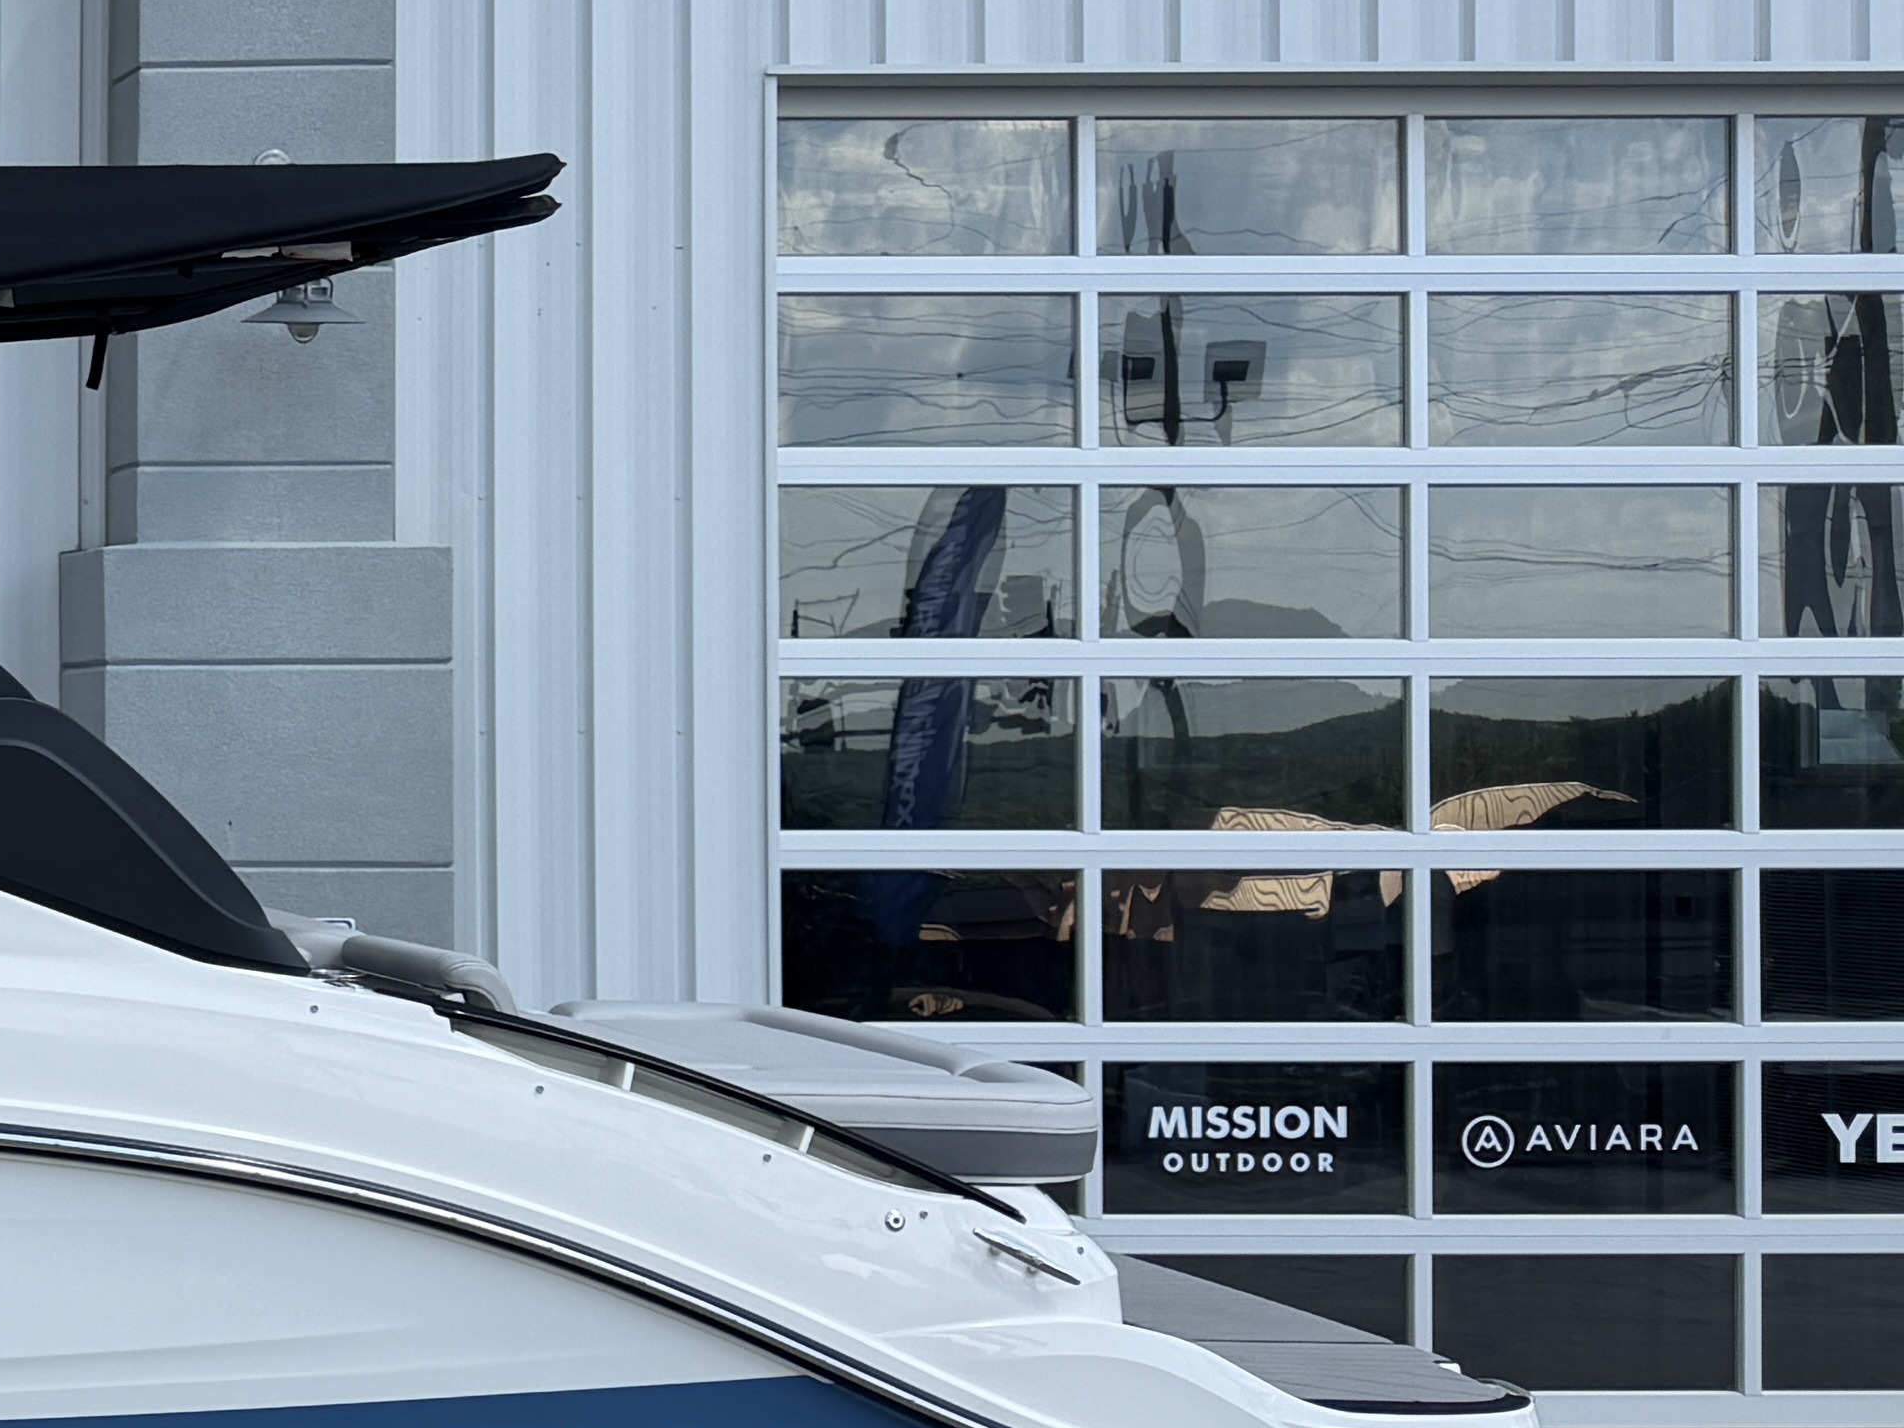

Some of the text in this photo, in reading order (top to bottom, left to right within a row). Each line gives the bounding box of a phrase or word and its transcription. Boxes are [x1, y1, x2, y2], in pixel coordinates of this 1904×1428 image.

[1149, 1106, 1347, 1138] MISSION
[1526, 1124, 1698, 1151] AVIARA
[1163, 1153, 1333, 1172] OUTDOOR
